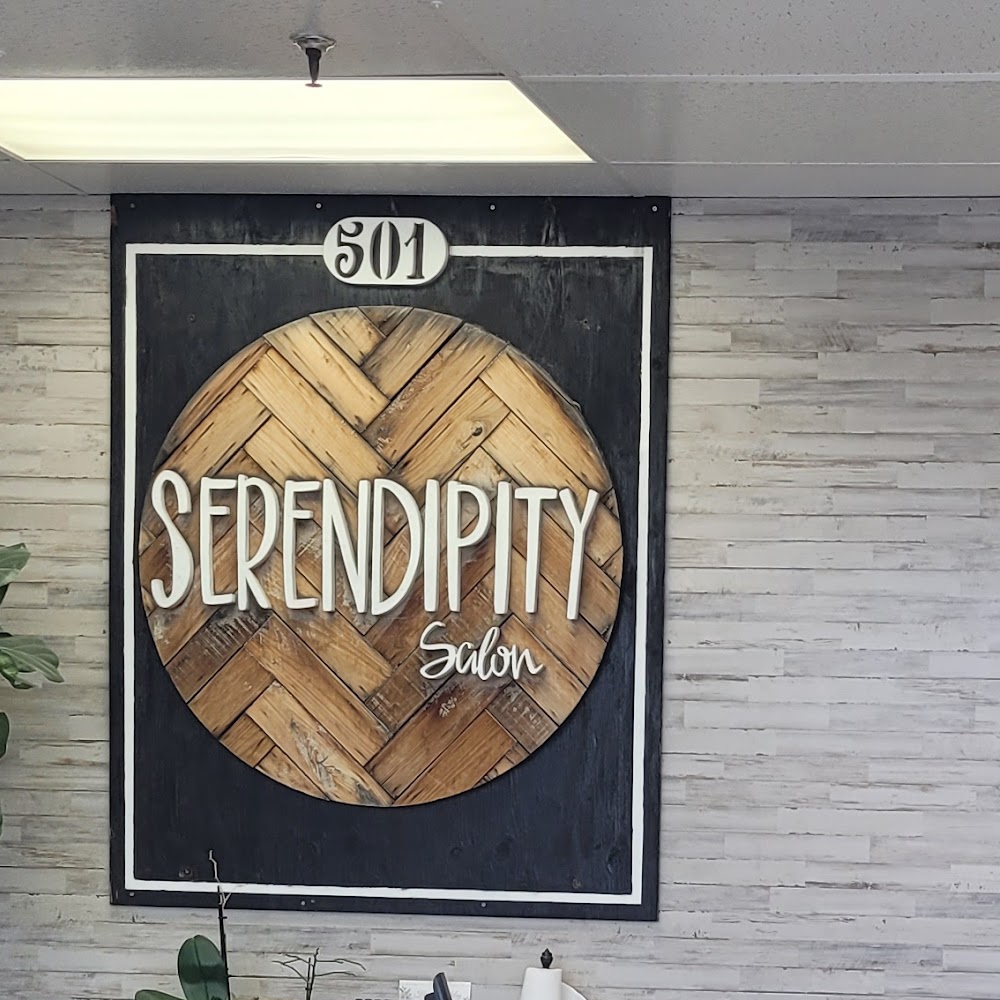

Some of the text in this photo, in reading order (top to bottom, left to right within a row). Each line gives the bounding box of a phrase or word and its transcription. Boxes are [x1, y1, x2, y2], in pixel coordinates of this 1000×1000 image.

[334, 220, 426, 281] 501
[150, 469, 599, 620] SERENDIPITY
[419, 621, 544, 681] Salon
